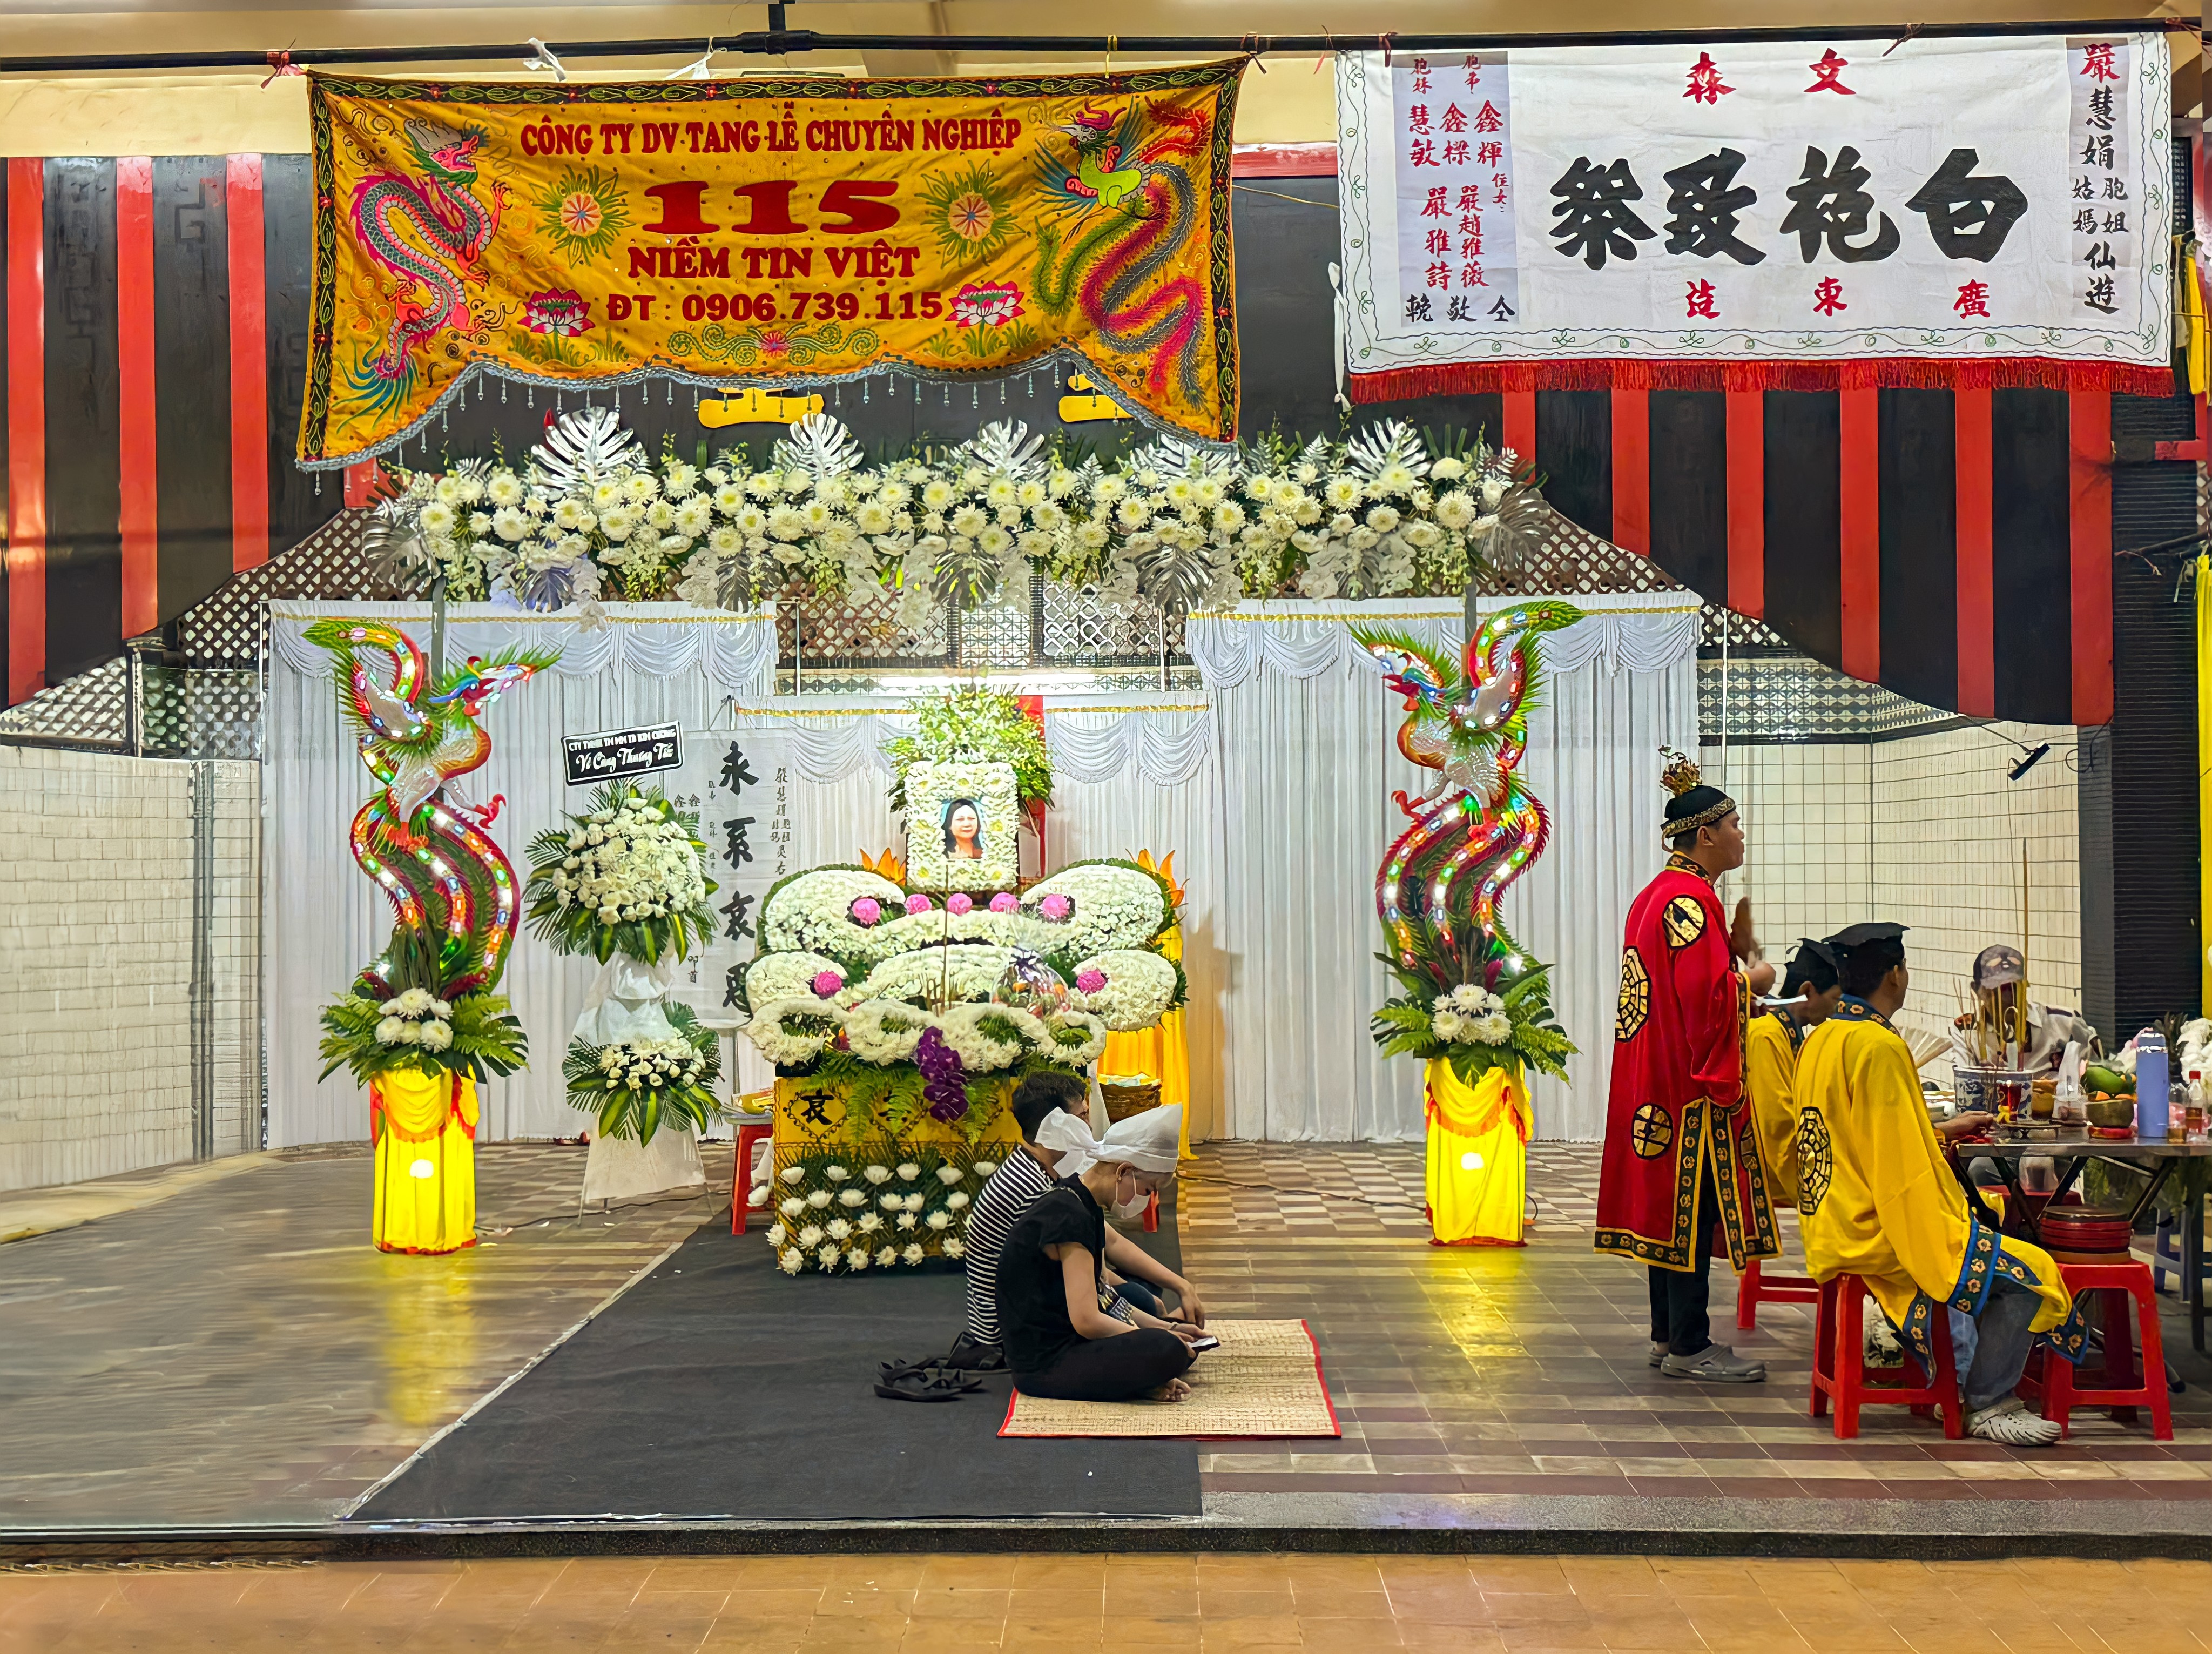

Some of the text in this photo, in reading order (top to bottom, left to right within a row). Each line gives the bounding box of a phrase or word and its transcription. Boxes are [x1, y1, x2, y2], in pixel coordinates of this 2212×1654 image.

[520, 103, 1022, 157] CÔNG TY DV TANG LỄ CHUYÊN NGHIỆP
[643, 180, 900, 236] 115
[627, 235, 920, 287] NIỀM TIN VIỆT
[682, 291, 943, 322] 0906.739.115
